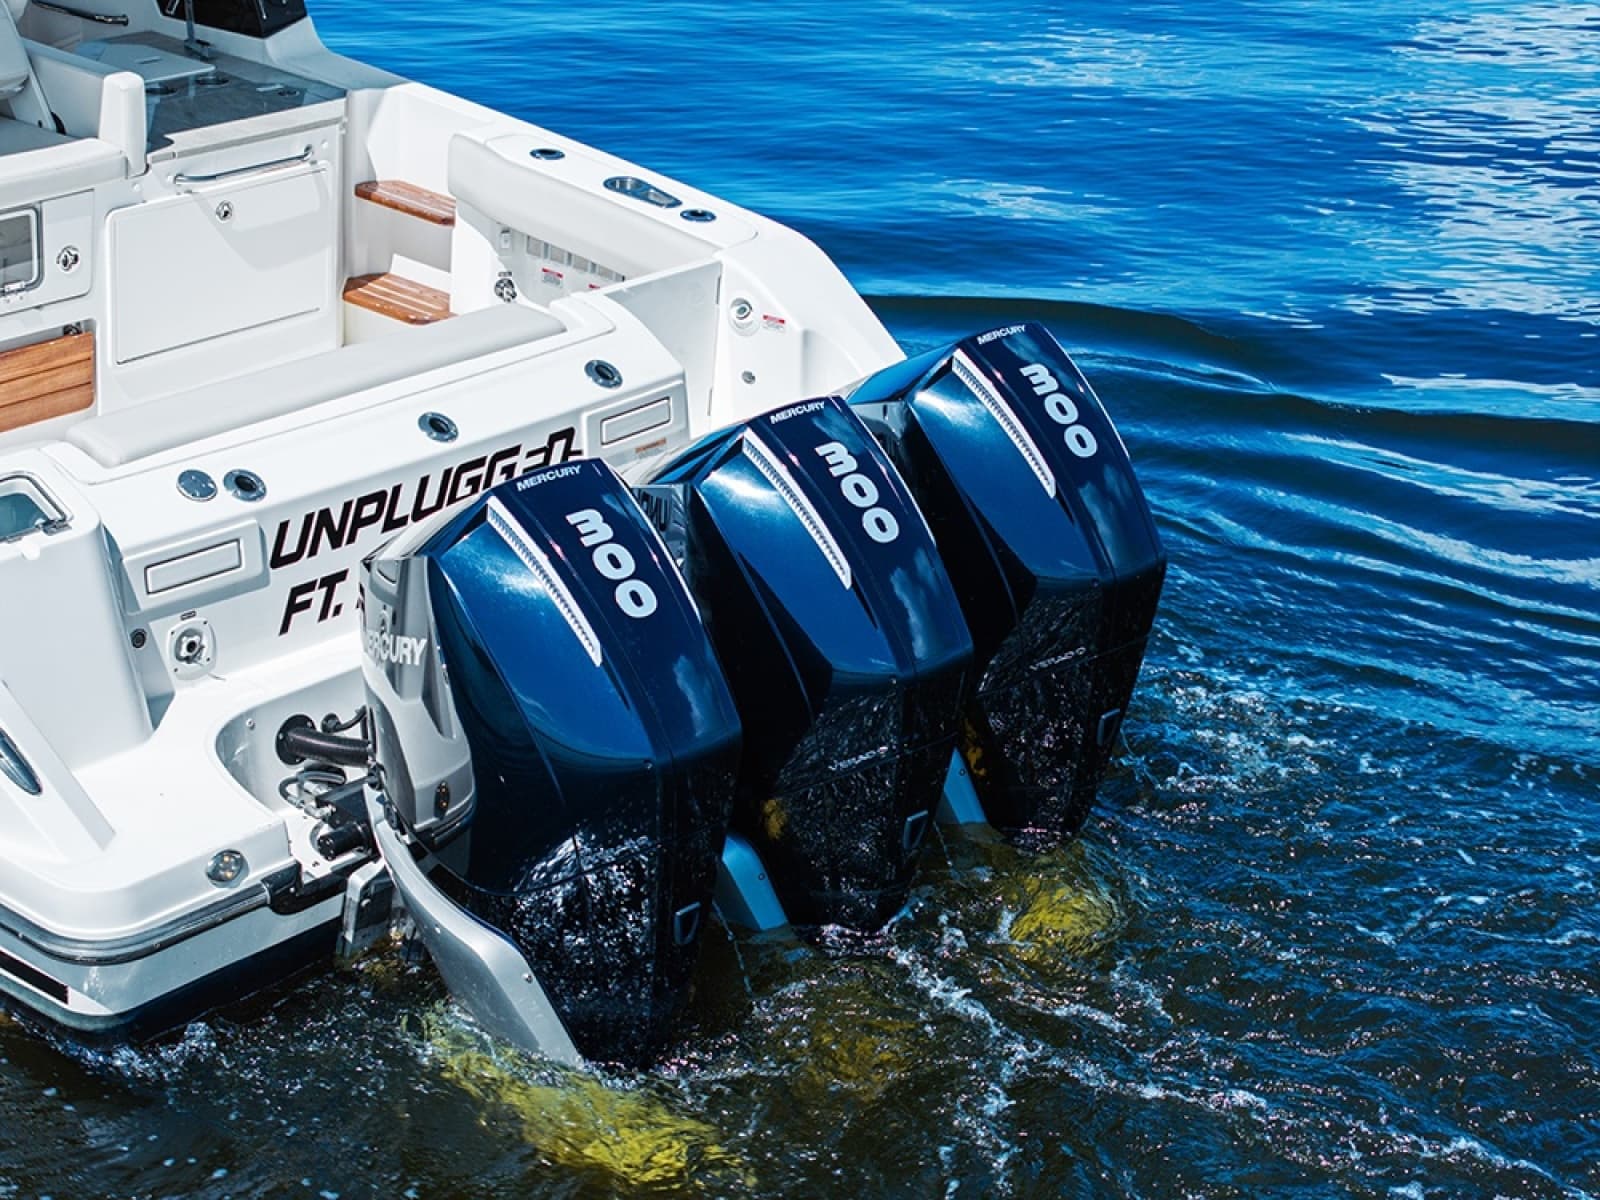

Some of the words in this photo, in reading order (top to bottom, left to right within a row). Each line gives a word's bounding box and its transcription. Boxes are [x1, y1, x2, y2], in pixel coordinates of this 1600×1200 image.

[976, 324, 1025, 345] MERCURY
[769, 400, 825, 425] MERCURY
[1019, 363, 1097, 457] 300
[516, 464, 581, 492] MERCURY
[814, 441, 899, 543] 300
[565, 509, 657, 618] 300
[278, 568, 349, 636] FT.
[365, 630, 428, 666] ERCURY
